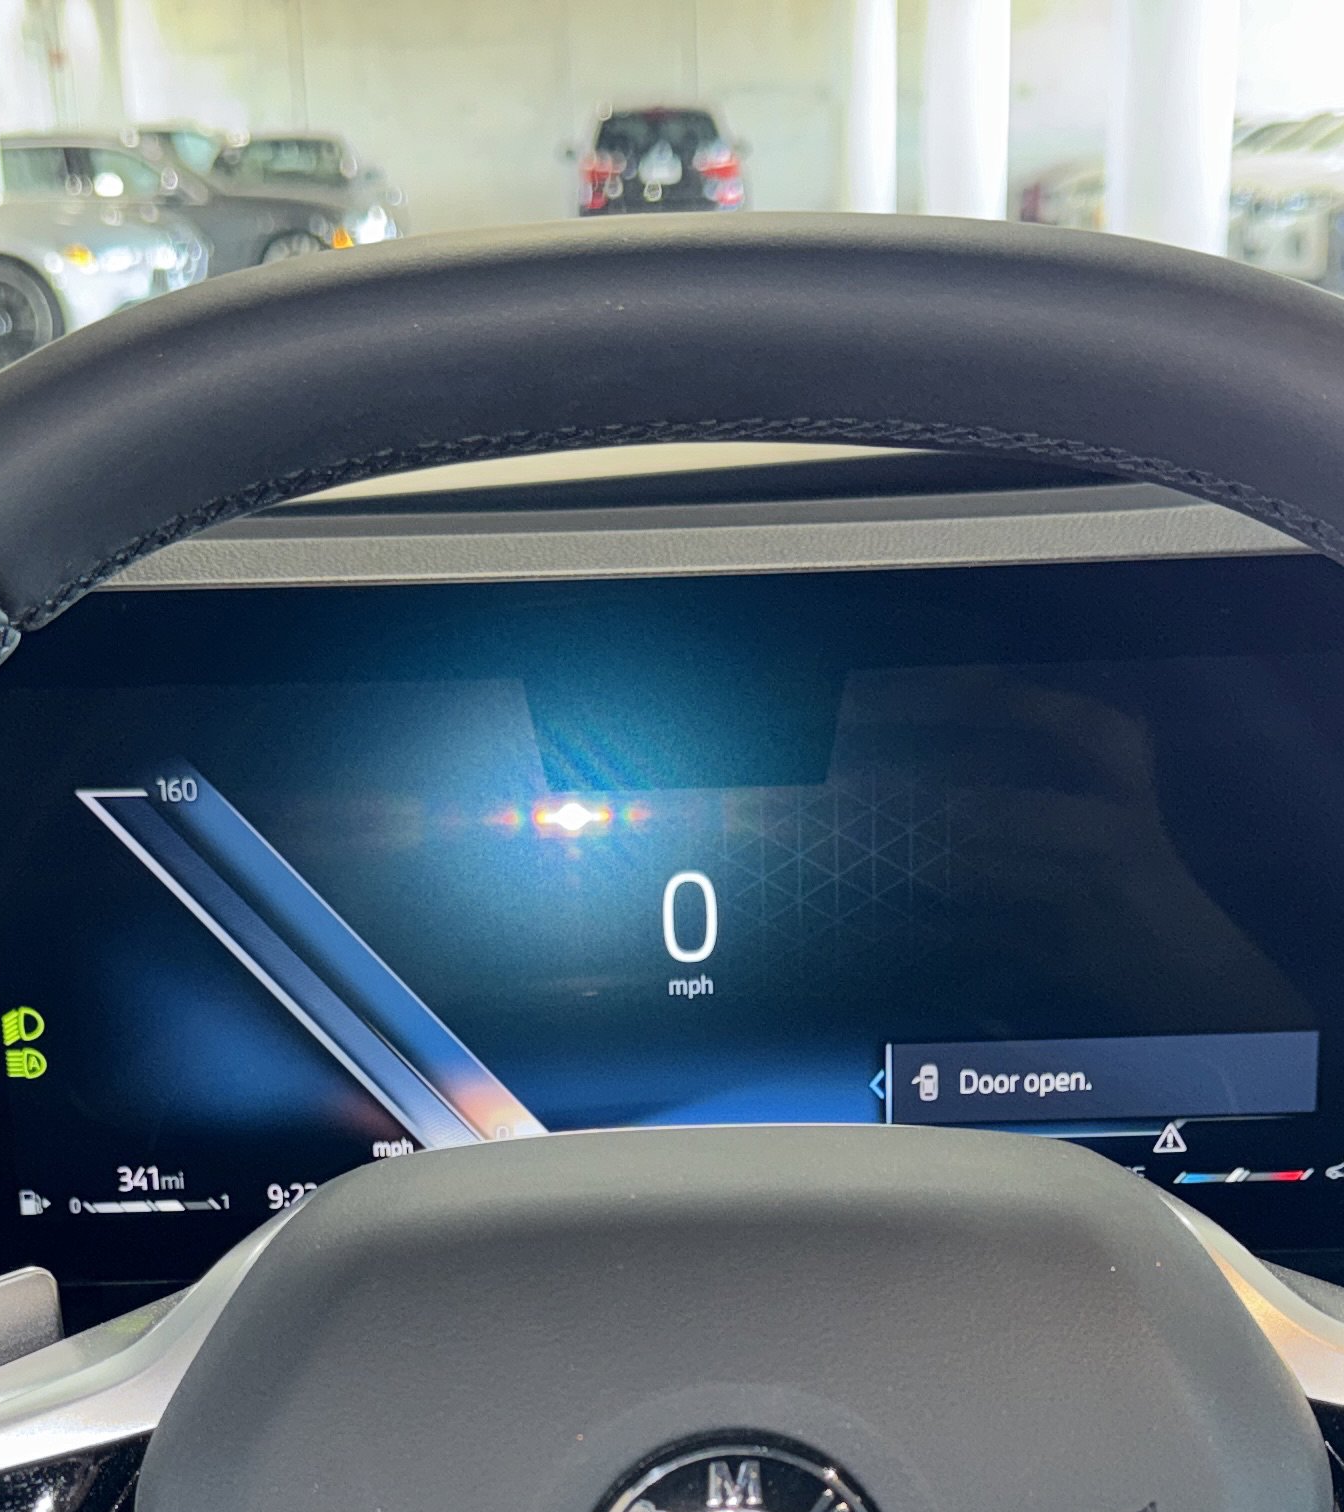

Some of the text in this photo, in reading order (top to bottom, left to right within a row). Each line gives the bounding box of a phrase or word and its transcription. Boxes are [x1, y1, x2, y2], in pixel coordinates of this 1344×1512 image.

[156, 777, 198, 802] 160
[662, 870, 718, 963] 0
[668, 974, 714, 1000] mph
[959, 1068, 1093, 1097] Door open.
[372, 1136, 414, 1158] mph
[68, 1197, 82, 1215] 0
[220, 1193, 230, 1210] 1
[267, 1182, 318, 1210] 9:2
